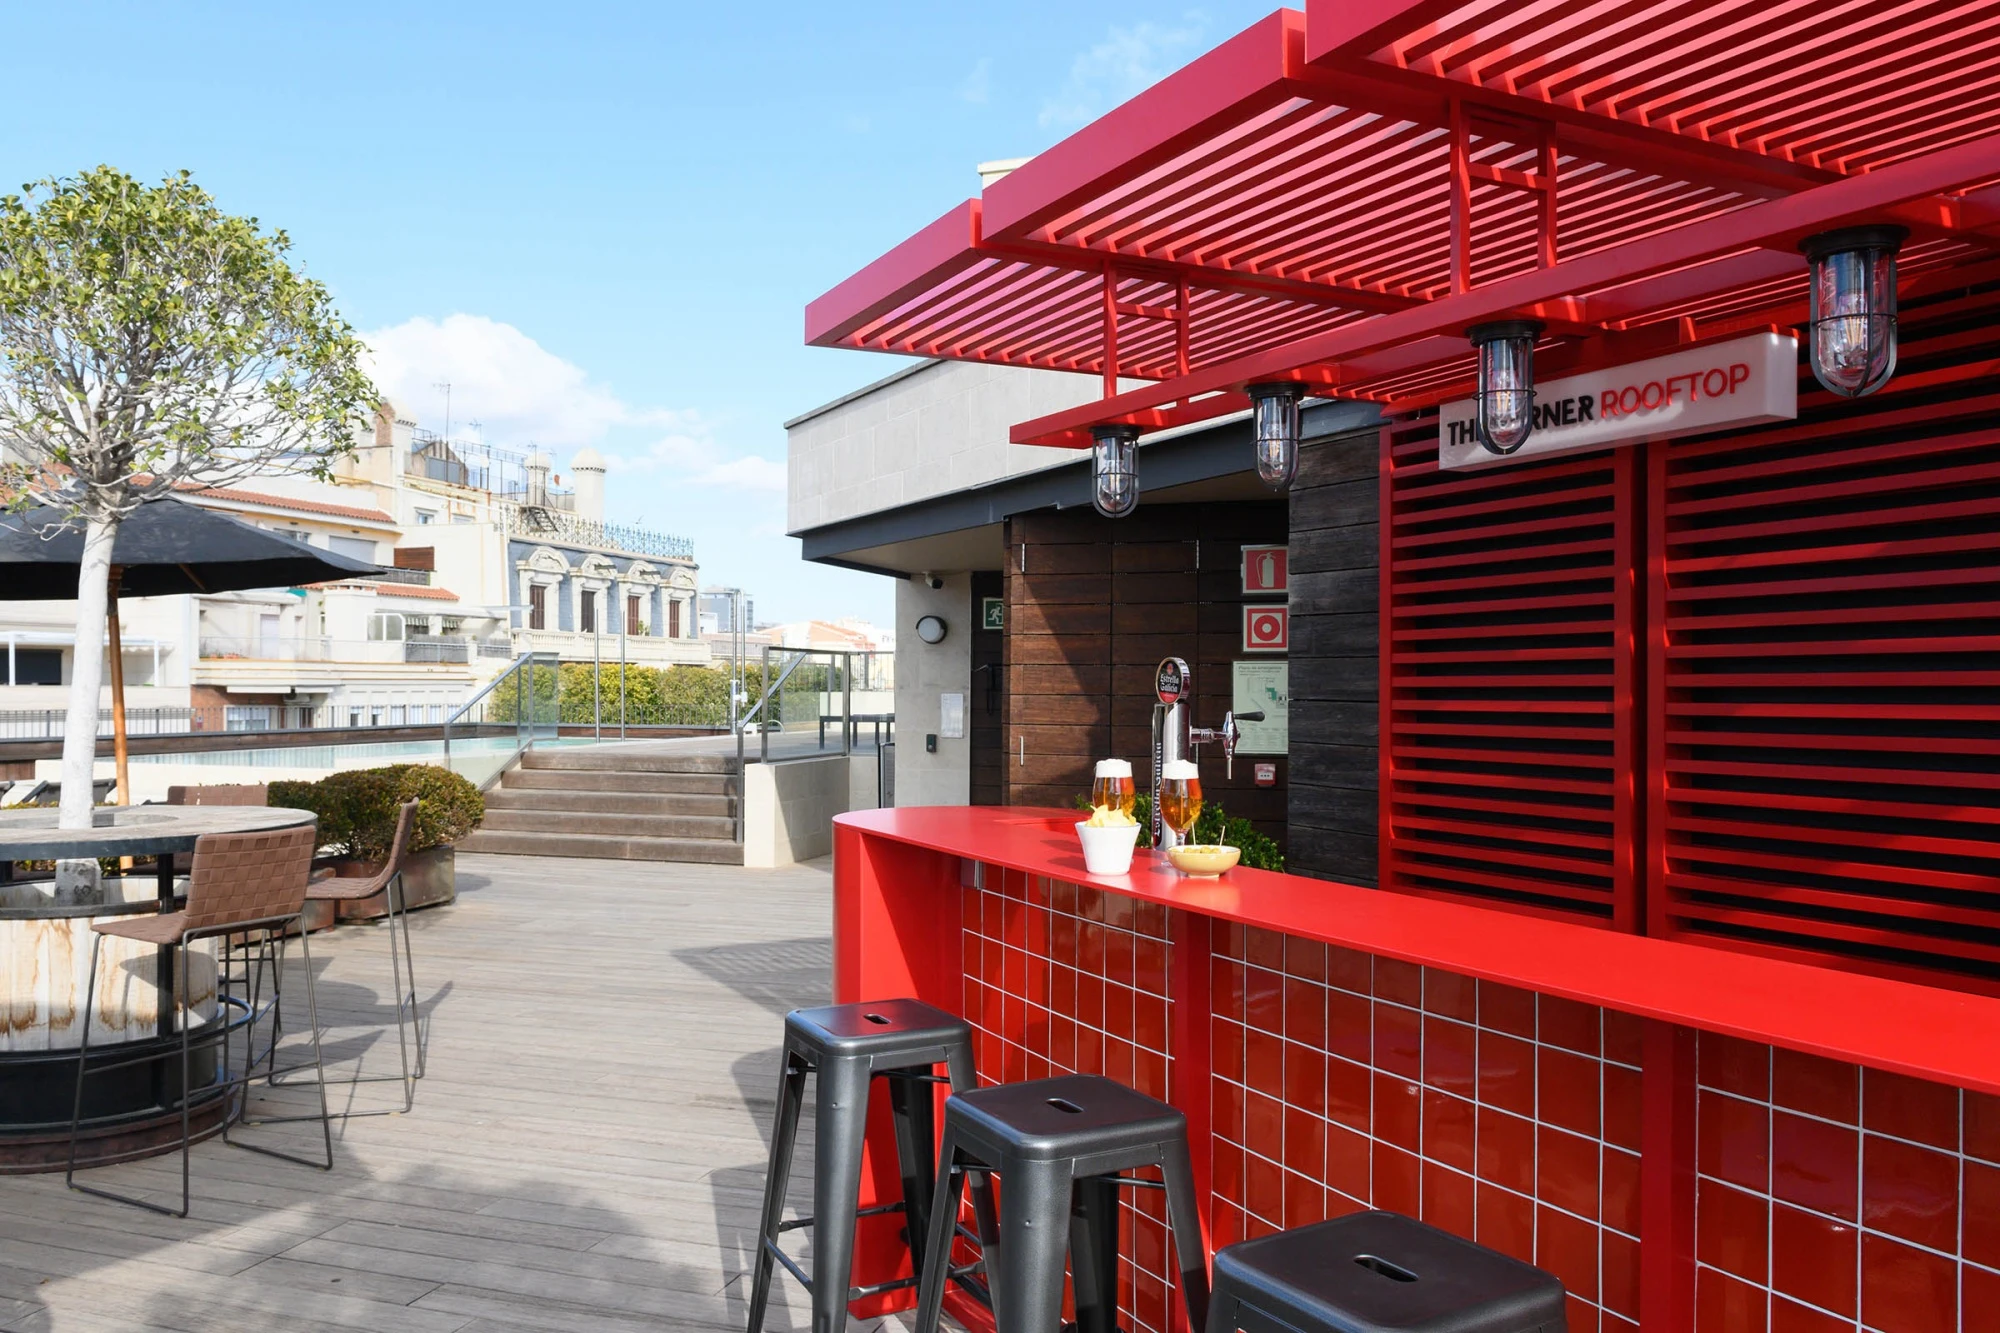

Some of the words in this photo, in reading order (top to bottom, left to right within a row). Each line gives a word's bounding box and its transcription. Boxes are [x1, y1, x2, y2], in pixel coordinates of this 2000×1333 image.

[1447, 417, 1482, 446] TH
[1531, 395, 1594, 430] RNER
[1601, 363, 1750, 418] ROOFTOP
[1160, 674, 1179, 685] Estrella
[1160, 682, 1178, 693] Galicia
